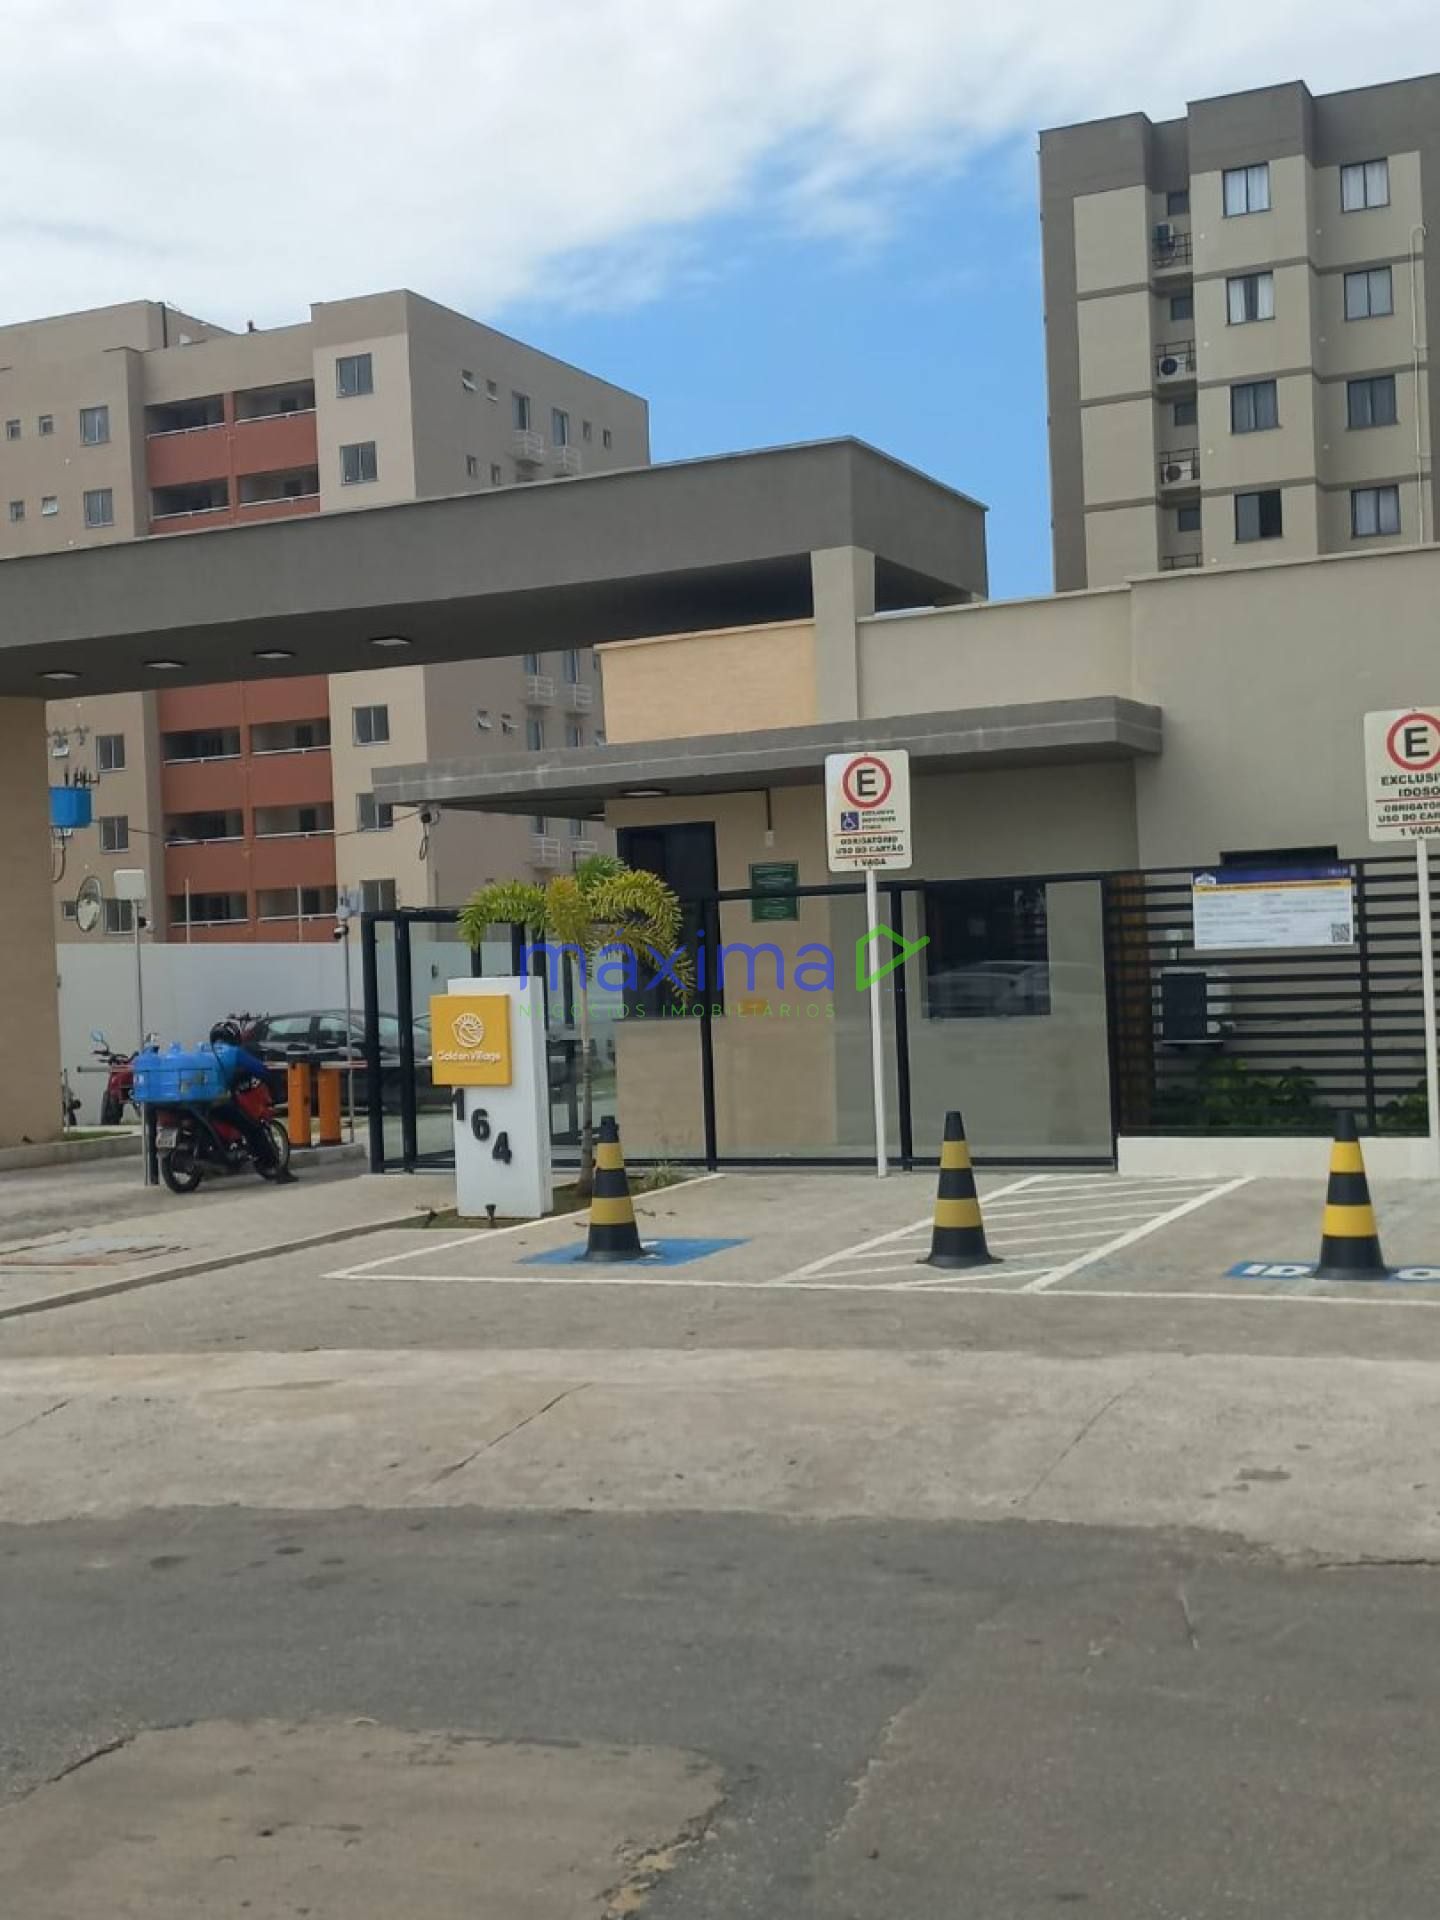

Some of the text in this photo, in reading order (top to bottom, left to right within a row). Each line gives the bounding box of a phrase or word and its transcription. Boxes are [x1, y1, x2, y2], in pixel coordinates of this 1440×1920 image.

[1404, 727, 1430, 759] E
[856, 769, 877, 796] E
[1398, 786, 1440, 797] IDOSO
[1378, 815, 1399, 823] USO
[1402, 813, 1416, 821] DO
[1410, 825, 1440, 835] VAGA
